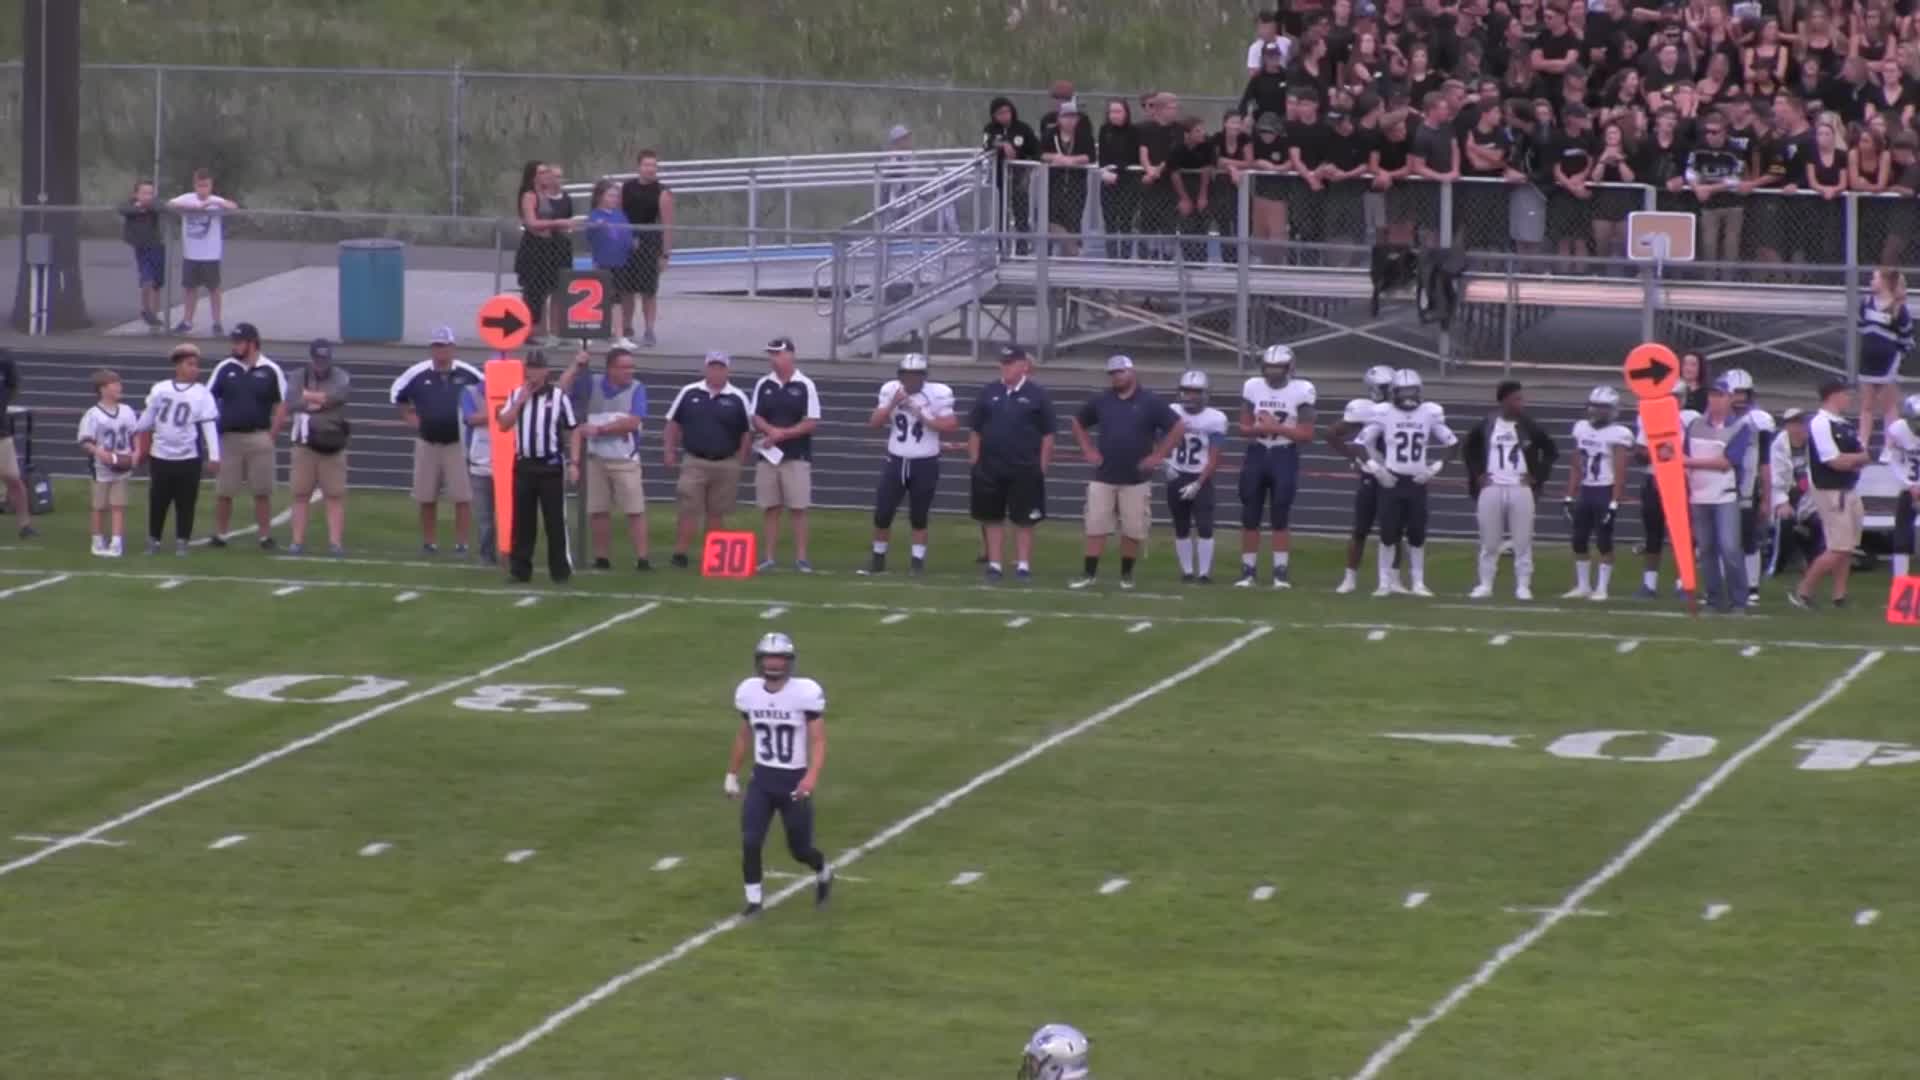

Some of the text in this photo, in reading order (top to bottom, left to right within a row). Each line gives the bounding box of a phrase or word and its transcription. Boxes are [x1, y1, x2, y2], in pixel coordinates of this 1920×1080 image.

[566, 278, 604, 323] 2
[159, 398, 191, 427] 70
[894, 413, 924, 443] 94
[1394, 431, 1424, 463] 26
[1496, 443, 1520, 470] 14
[707, 538, 749, 574] 30
[1893, 584, 1920, 620] 4
[753, 722, 795, 764] 30
